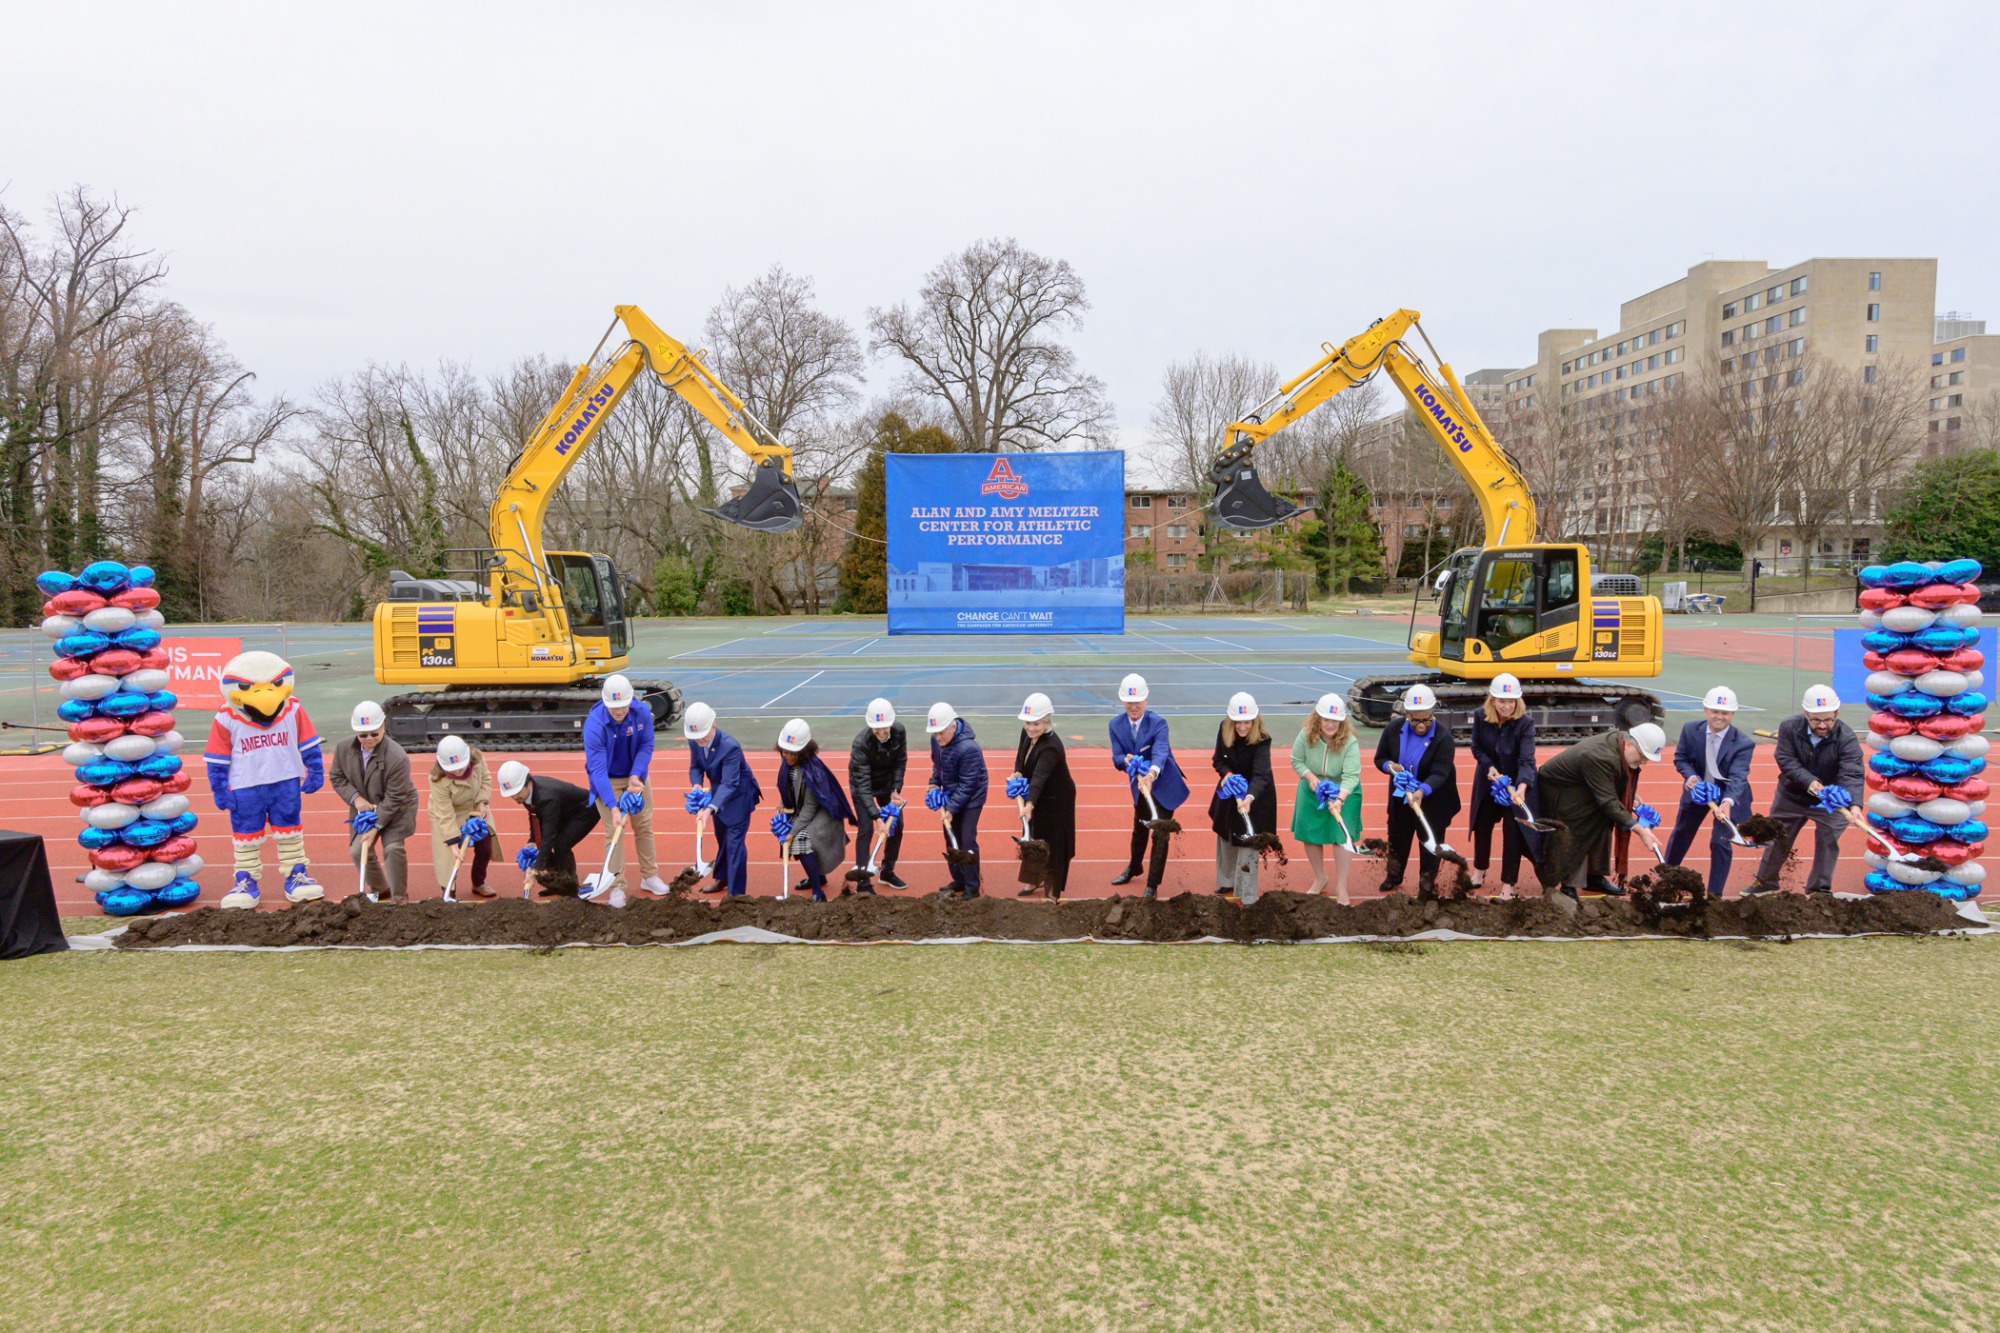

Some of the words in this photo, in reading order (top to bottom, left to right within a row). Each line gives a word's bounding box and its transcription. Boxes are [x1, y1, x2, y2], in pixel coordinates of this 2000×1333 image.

[554, 383, 614, 456] KOMATSU
[1413, 383, 1474, 453] KOMATSU
[983, 483, 1027, 492] AMERICAN
[910, 507, 951, 518] ALAN
[954, 507, 987, 518] AND
[990, 506, 1025, 518] AMY
[1028, 506, 1100, 517] MELTZER
[919, 521, 980, 532] CENTER
[983, 520, 1014, 532] FOR
[1017, 520, 1091, 531] ATHLETIC
[947, 534, 1063, 546] PERFORMANCE
[957, 612, 999, 620] CHANGE
[1001, 611, 1027, 620] CAN'T
[1029, 611, 1053, 620] WAIT
[421, 648, 435, 656] PC
[166, 665, 222, 680] TMAN
[240, 731, 289, 754] AMERICAN
